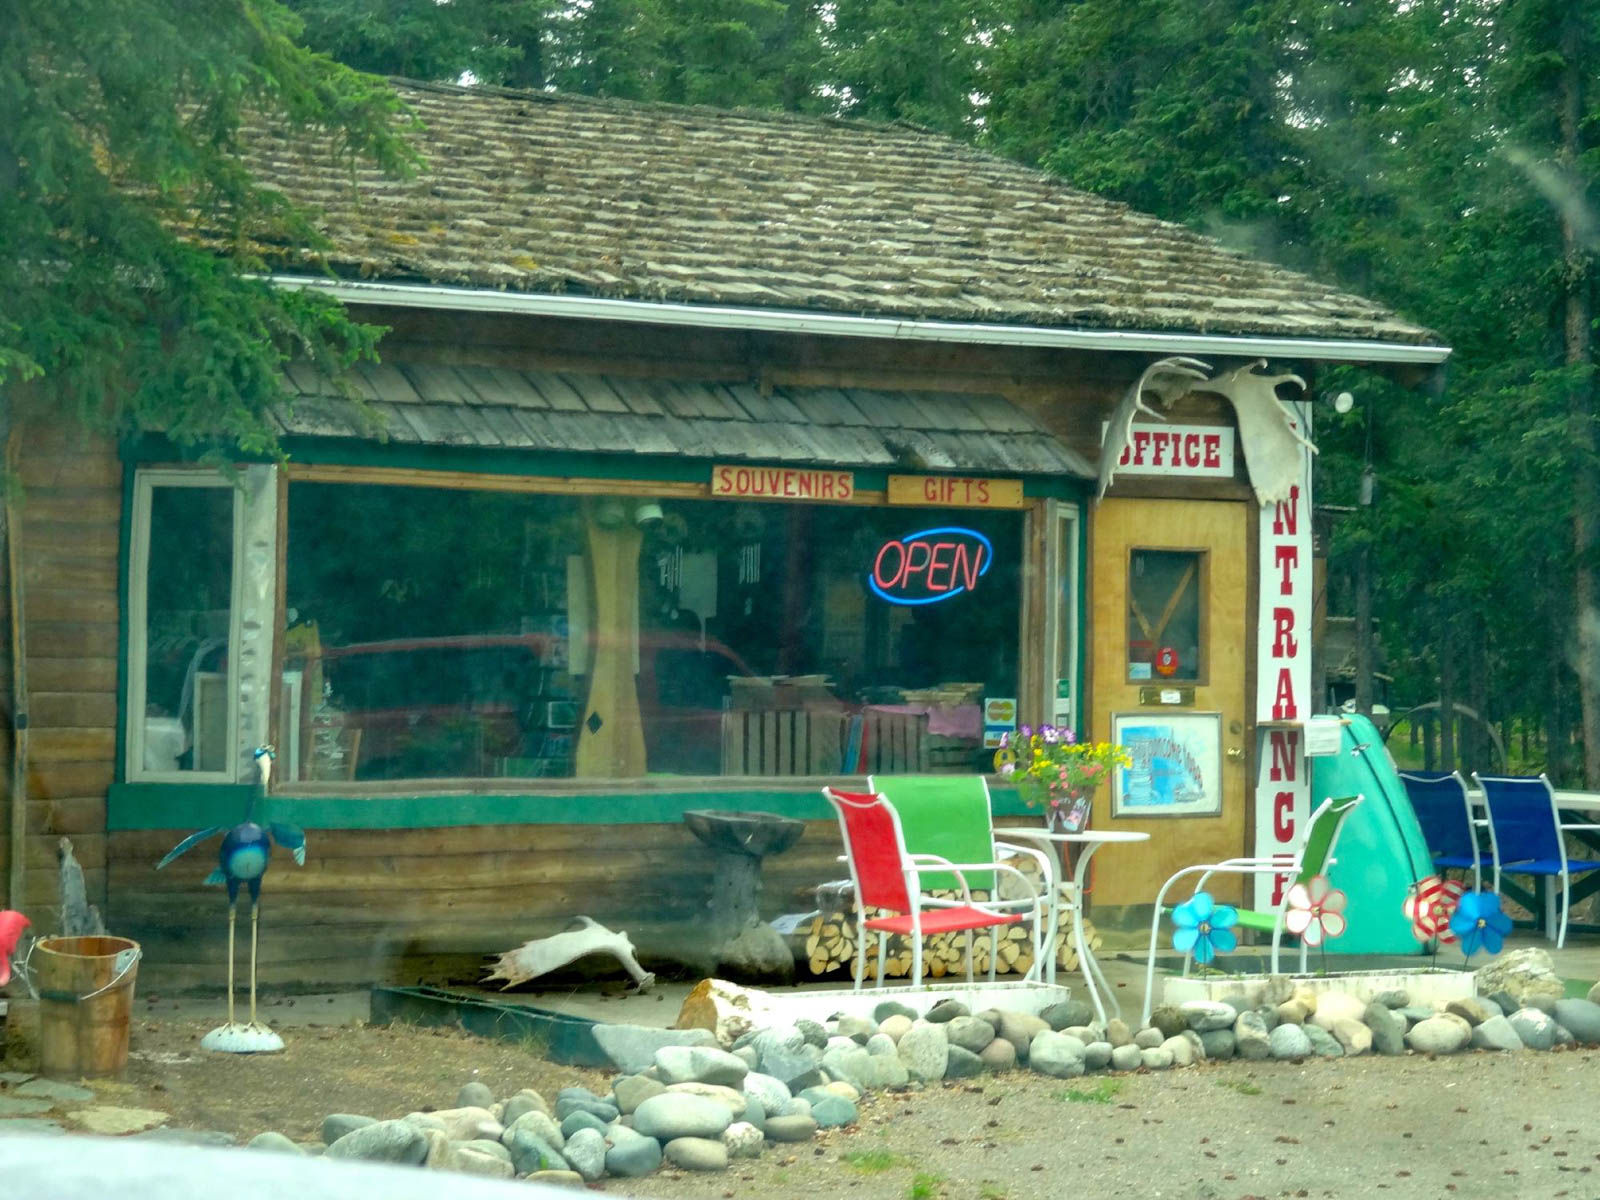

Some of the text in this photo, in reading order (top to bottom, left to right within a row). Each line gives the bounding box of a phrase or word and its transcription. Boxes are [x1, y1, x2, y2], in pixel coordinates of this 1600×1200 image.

[718, 467, 851, 499] SOUVENIRS
[923, 478, 991, 504] GIFTS
[873, 540, 984, 591] OPEN
[1270, 422, 1298, 906] NTRANC
